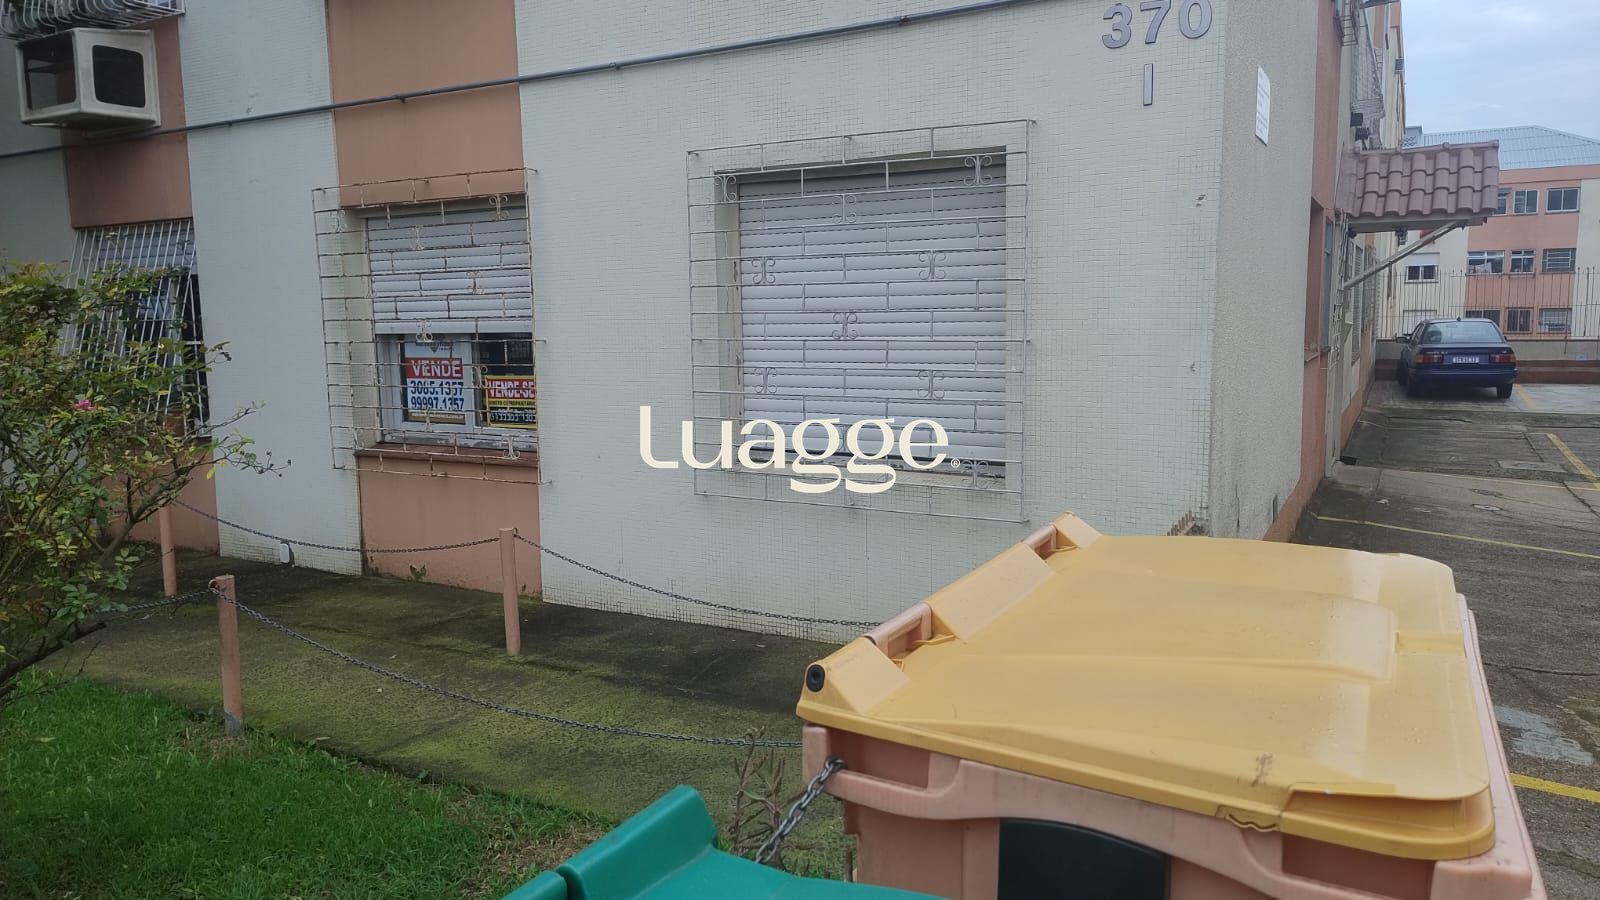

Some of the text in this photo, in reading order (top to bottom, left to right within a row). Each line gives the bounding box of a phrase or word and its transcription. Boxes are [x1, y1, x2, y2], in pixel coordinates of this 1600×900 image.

[1102, 0, 1213, 49] 370
[411, 359, 462, 378] VENDE
[410, 380, 465, 396] 3085.1357
[488, 380, 536, 399] VENDE-SE
[410, 396, 465, 410] 99997.1357
